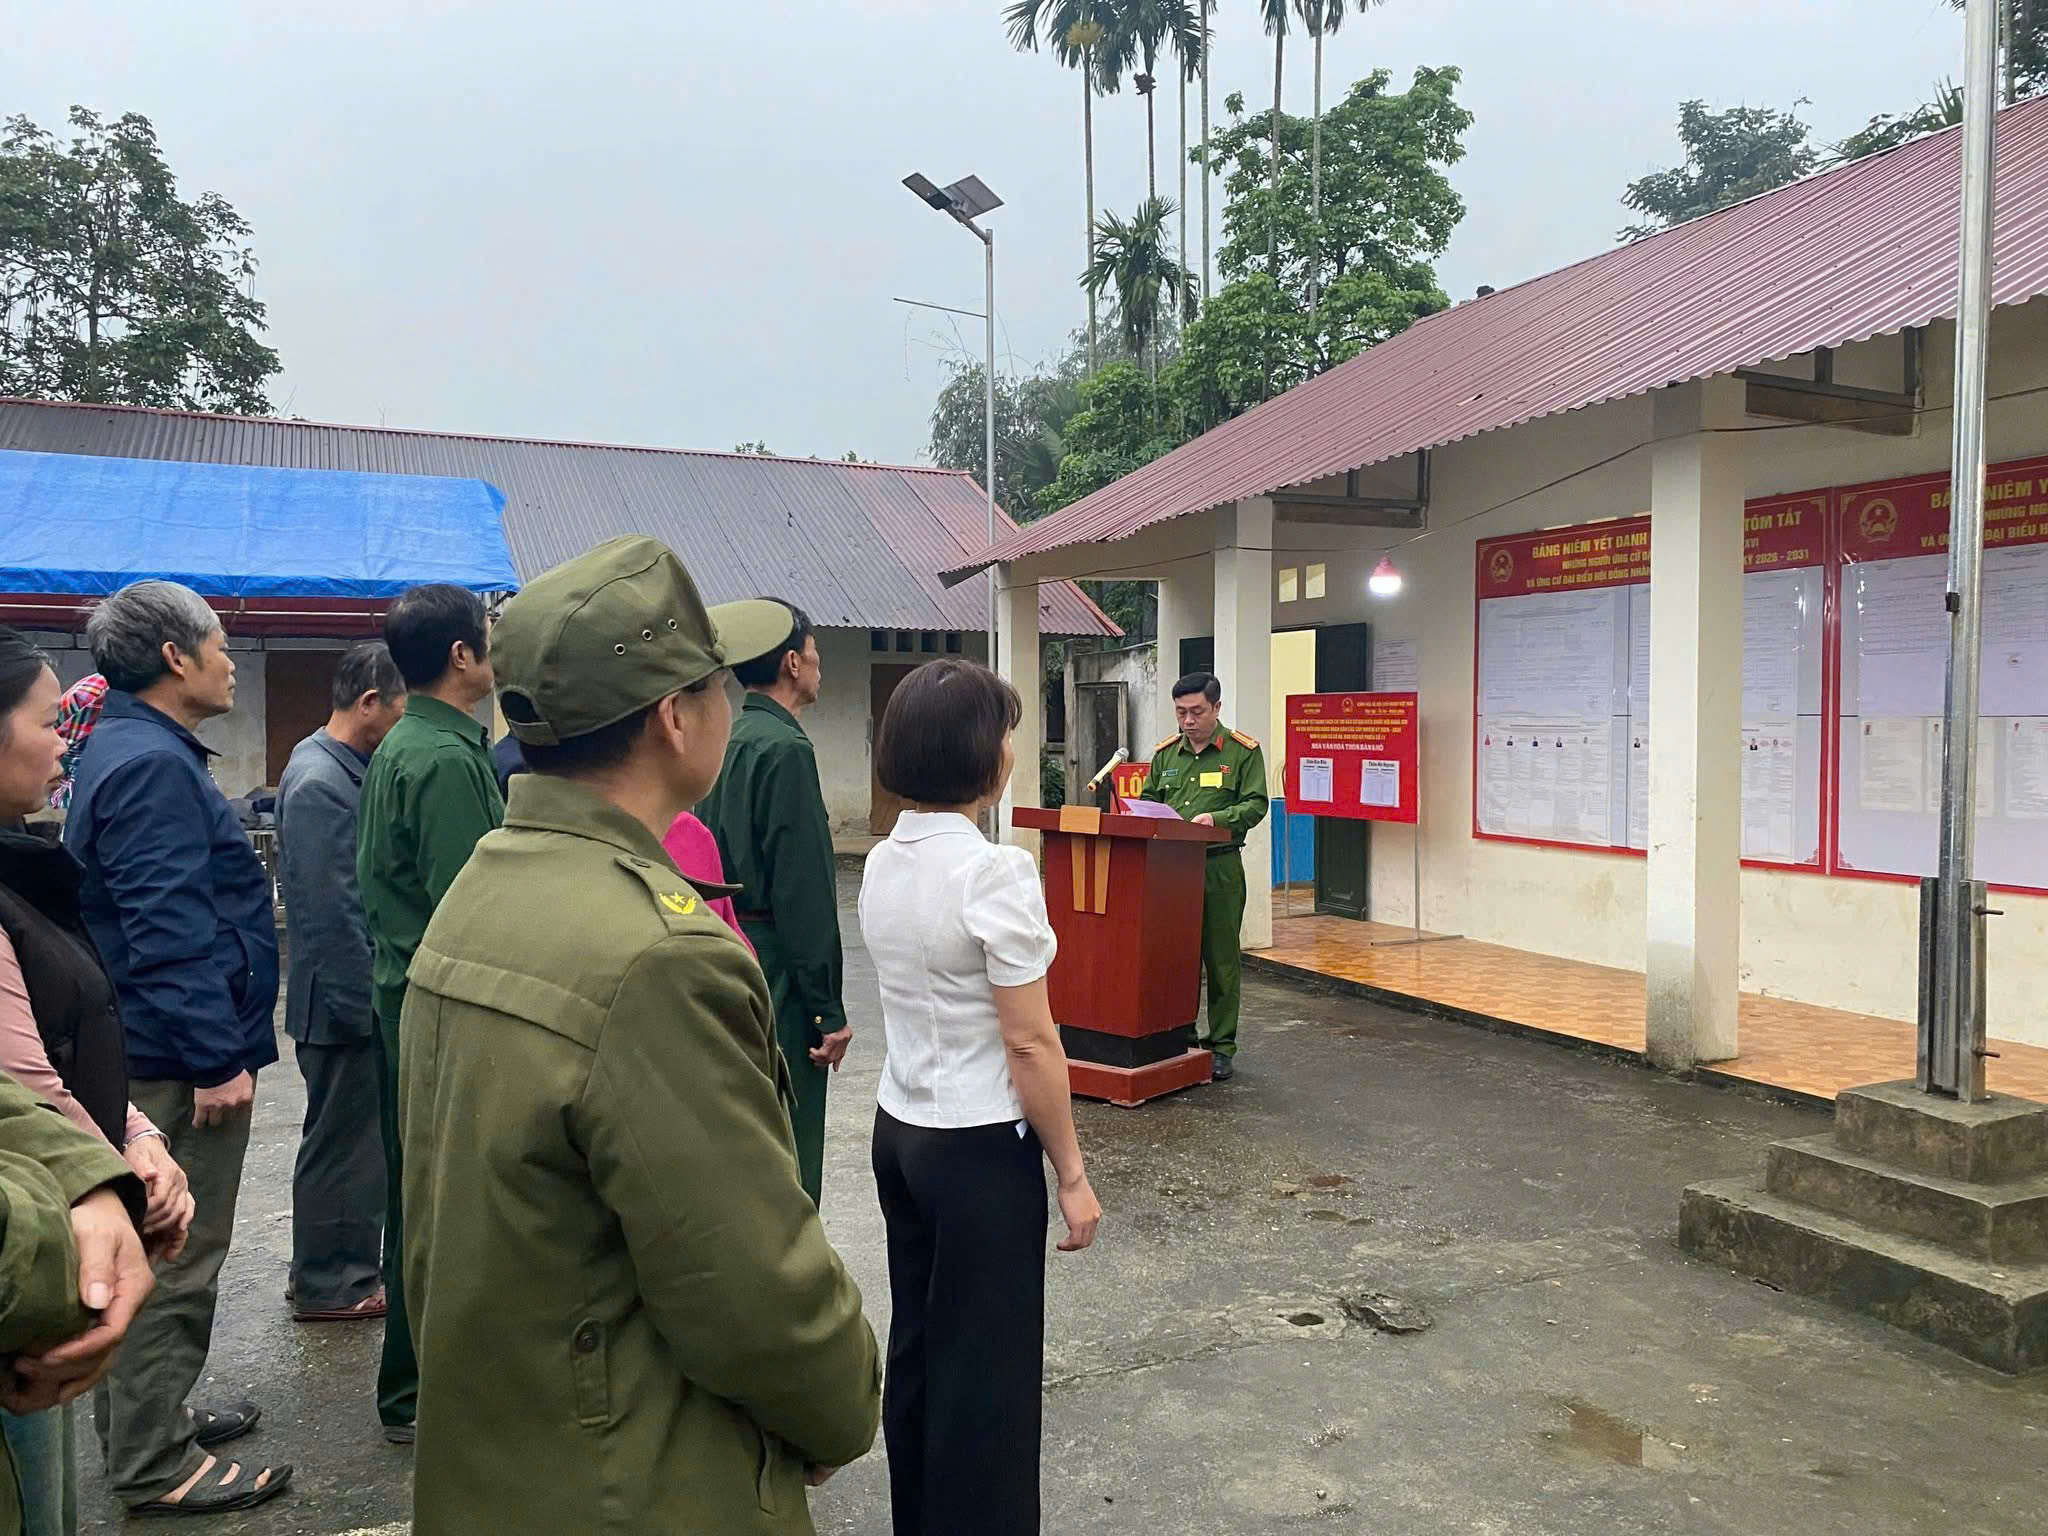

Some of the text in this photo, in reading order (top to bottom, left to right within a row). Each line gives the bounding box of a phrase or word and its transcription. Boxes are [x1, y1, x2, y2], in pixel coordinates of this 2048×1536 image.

[1532, 542, 1560, 559] BẢNG
[1563, 539, 1590, 555] NIÊM
[1593, 534, 1614, 550] YẾT
[1616, 532, 1648, 548] DANH
[1119, 768, 1147, 797] LỐ
